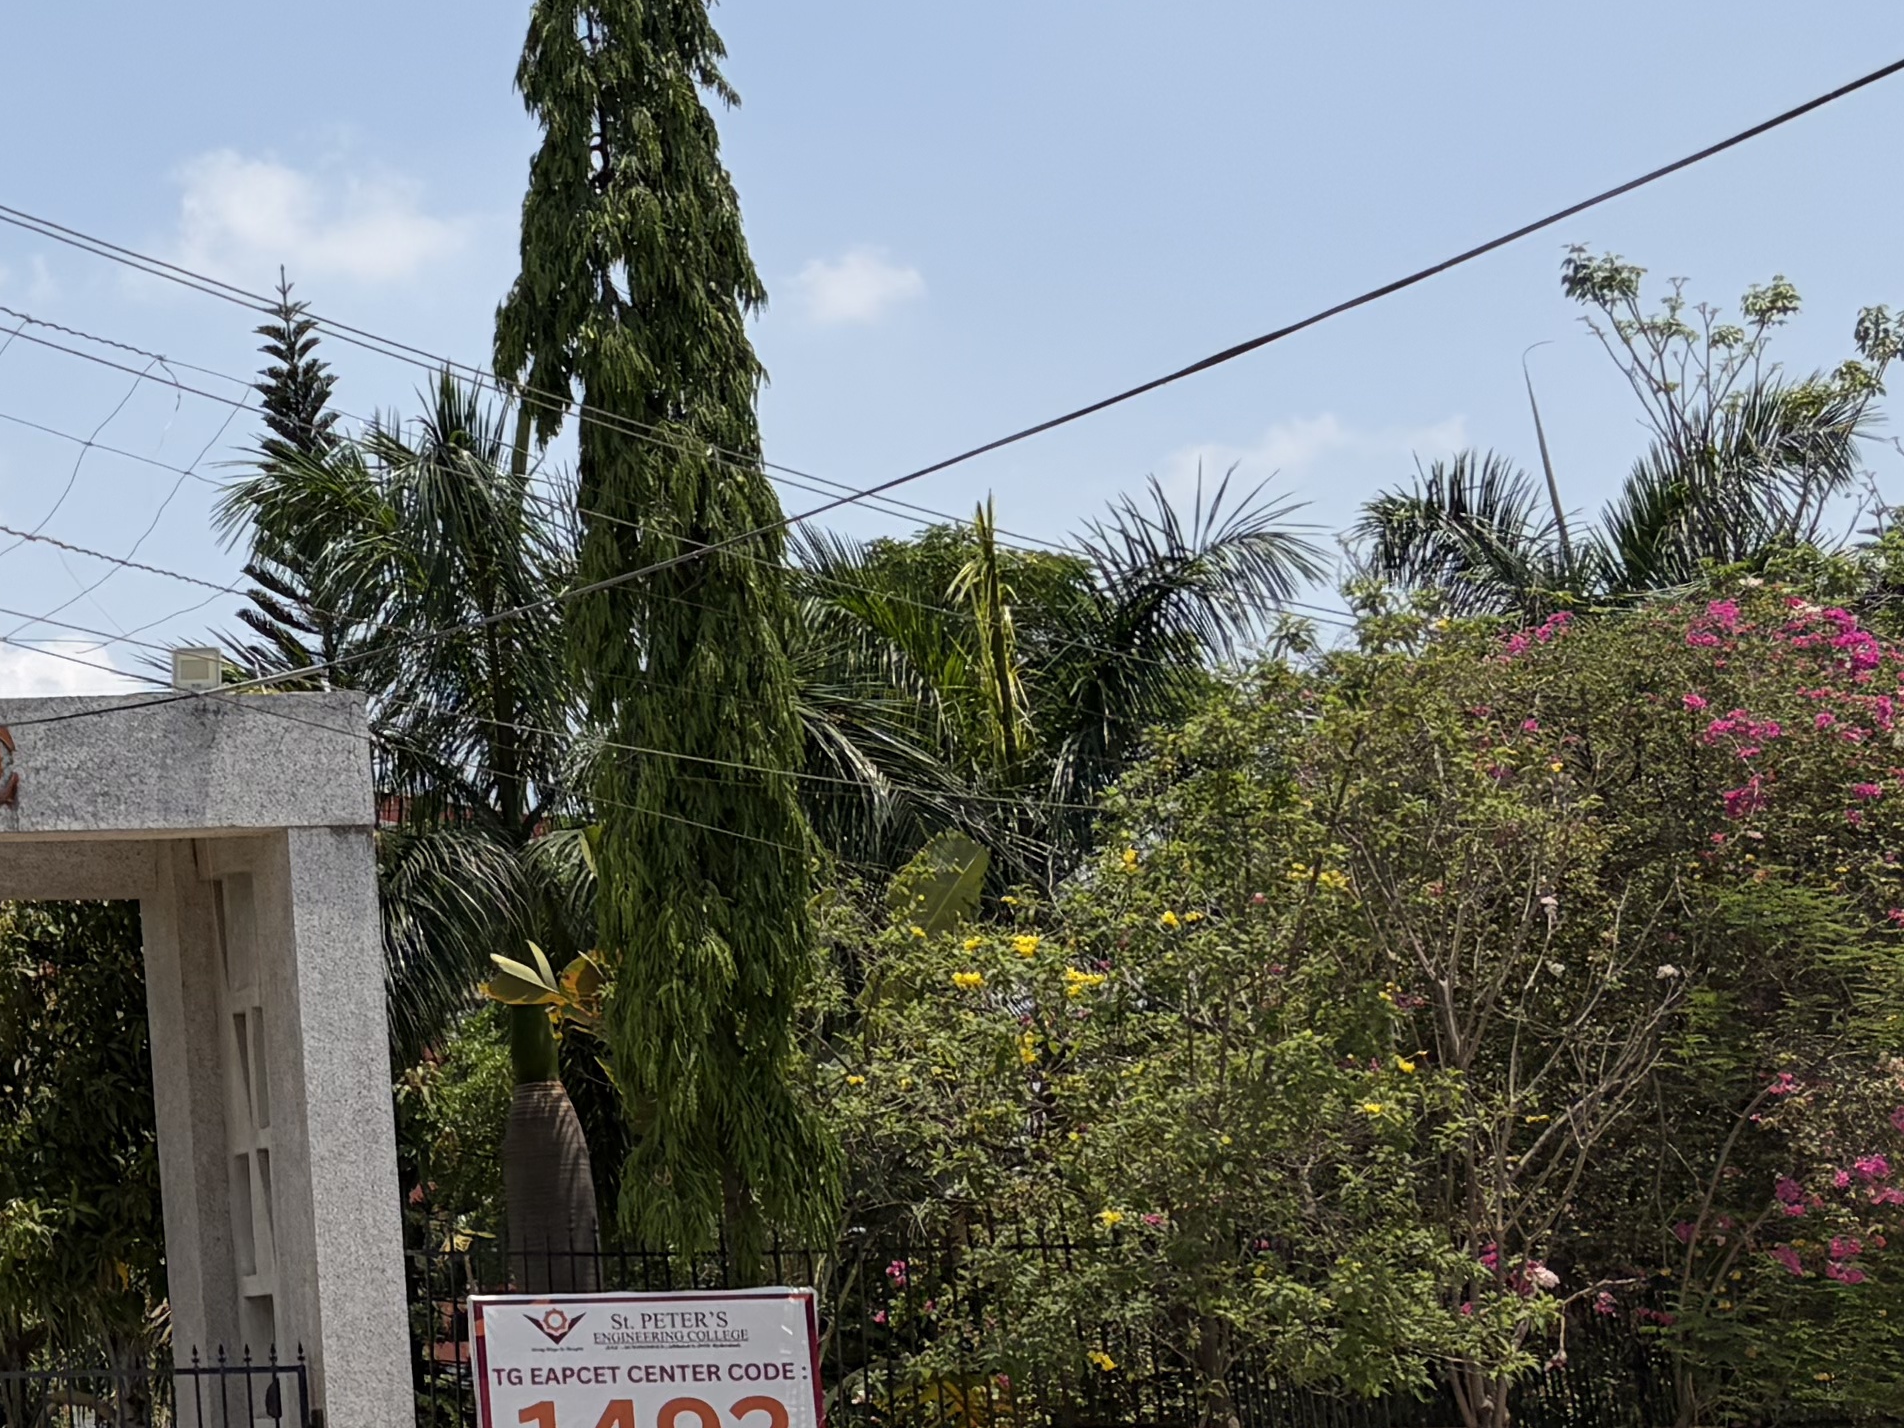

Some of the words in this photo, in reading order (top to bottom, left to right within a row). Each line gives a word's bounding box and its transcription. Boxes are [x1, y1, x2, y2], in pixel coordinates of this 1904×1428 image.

[611, 1313, 634, 1330] St.
[642, 1311, 728, 1329] PETER'S
[593, 1330, 685, 1345] ENGINEERING
[687, 1328, 749, 1342] COLLEGE
[493, 1367, 523, 1386] TG
[531, 1365, 621, 1385] EAPCET
[627, 1364, 721, 1383] CENTER
